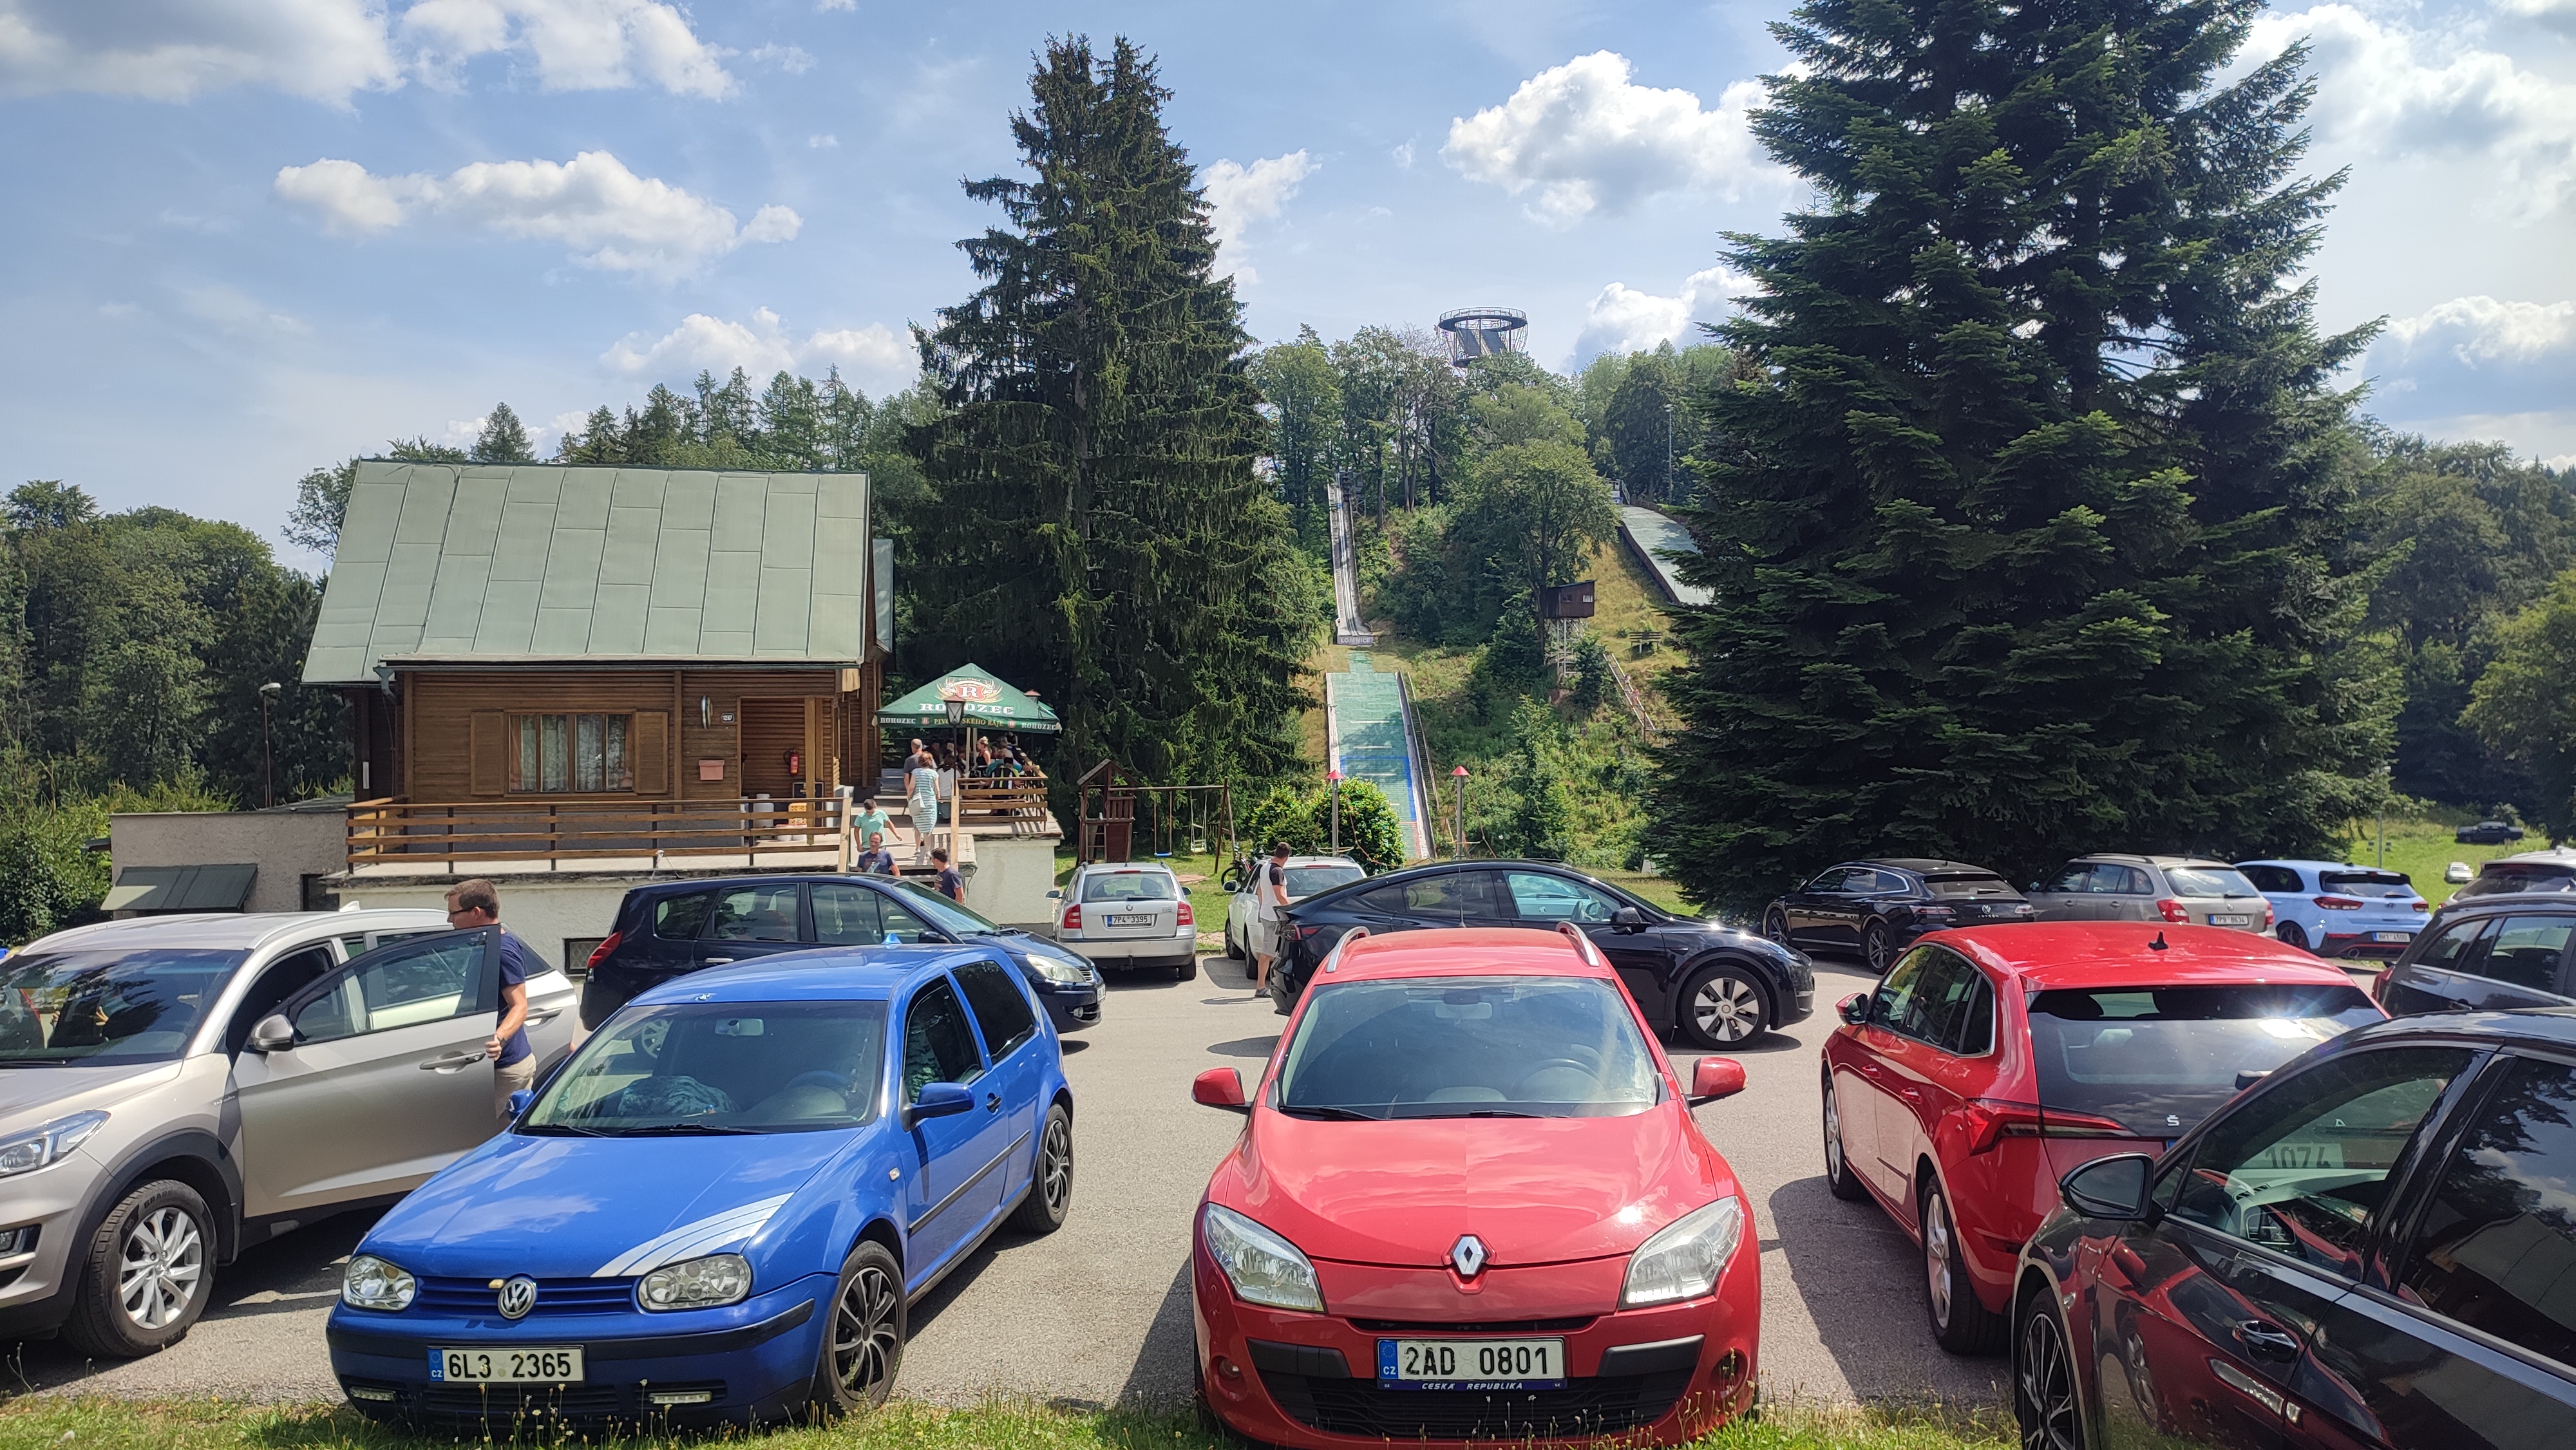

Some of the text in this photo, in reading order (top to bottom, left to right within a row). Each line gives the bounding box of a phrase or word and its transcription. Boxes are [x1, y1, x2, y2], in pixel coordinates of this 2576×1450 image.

[919, 703, 1014, 714] ROOZEC
[961, 717, 987, 726] SKÉHO
[2265, 1146, 2331, 1168] 1074
[431, 1353, 571, 1379] CZ 6L3 2365
[1383, 1346, 1548, 1375] CZ 2AD 0801
[1466, 1382, 1523, 1390] REPUBLIKA
